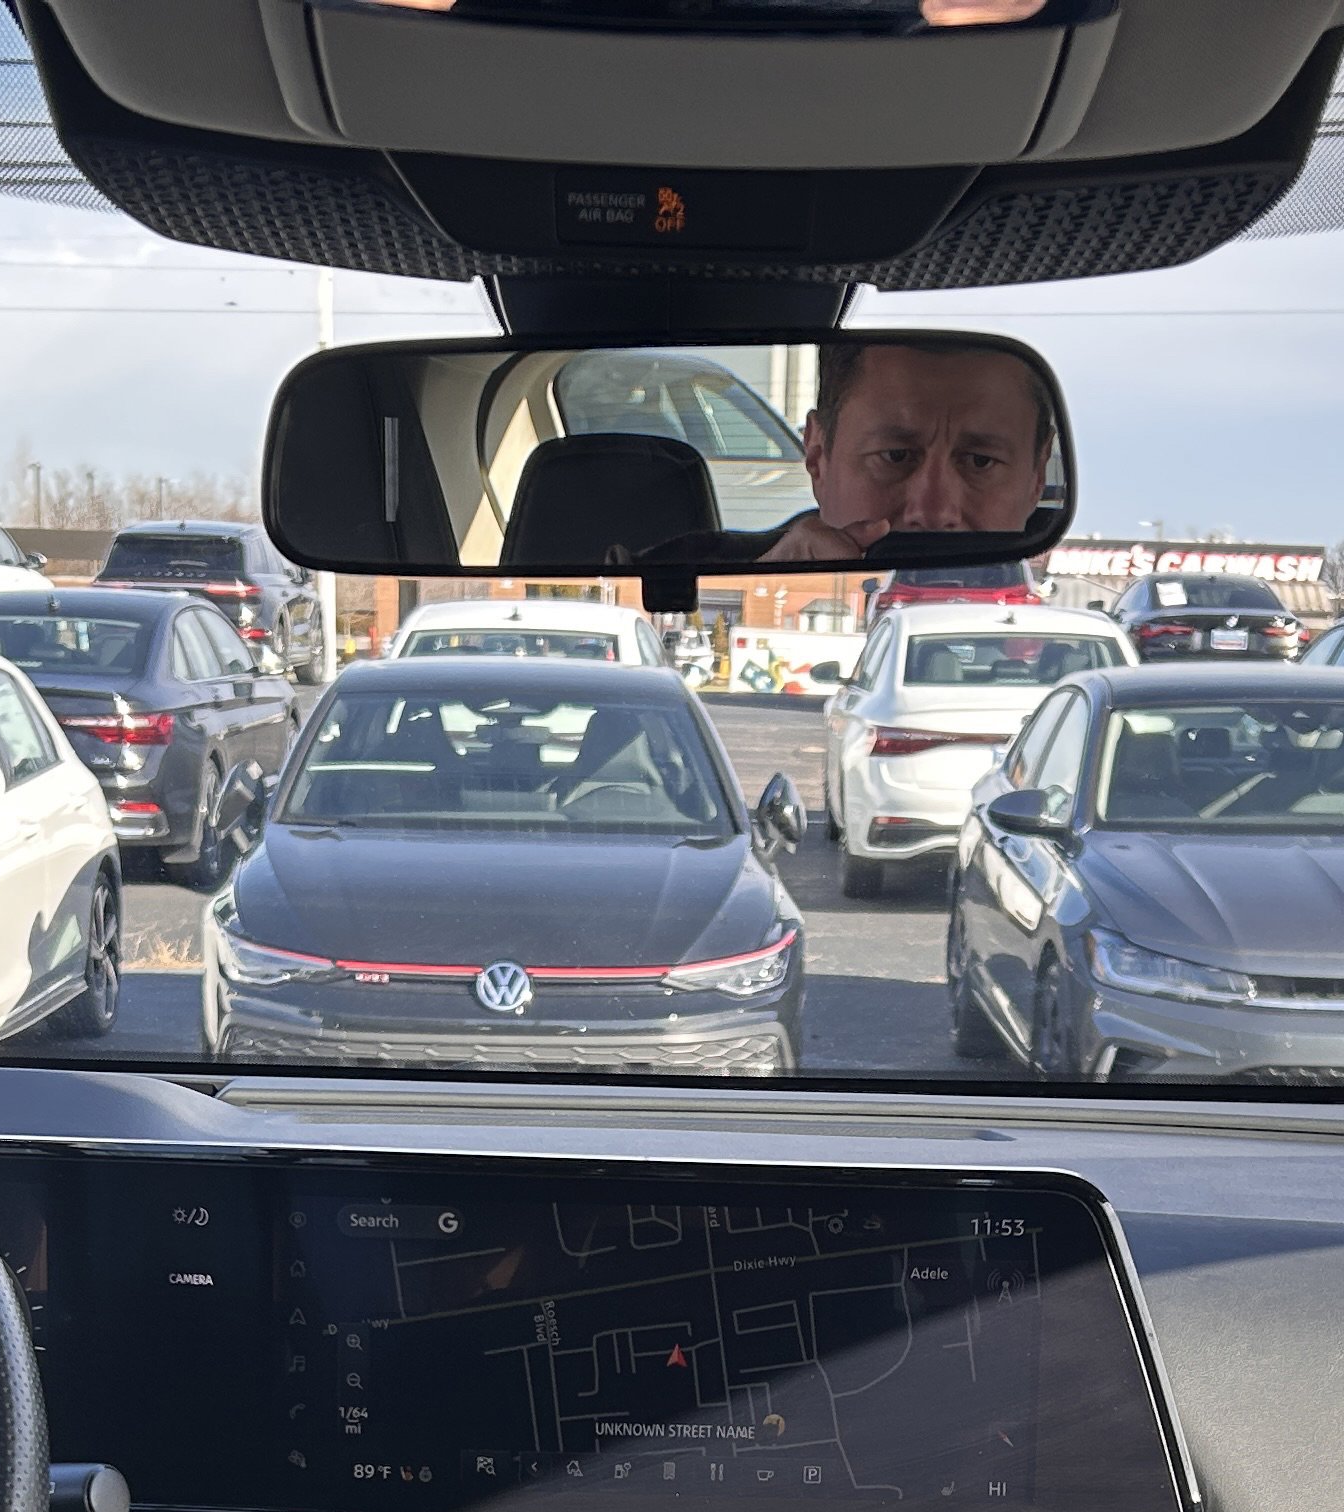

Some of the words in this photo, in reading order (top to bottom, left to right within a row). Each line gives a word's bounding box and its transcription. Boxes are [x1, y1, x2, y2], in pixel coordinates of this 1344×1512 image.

[567, 191, 646, 208] PASSENGER
[578, 208, 602, 222] AIR
[606, 208, 634, 222] BAG
[655, 217, 686, 232] OFF
[1046, 544, 1155, 577] MIKE'S
[1156, 551, 1324, 582] CARWASH
[349, 1213, 399, 1229] Search
[971, 1218, 1025, 1237] 11:53
[733, 1258, 765, 1272] Dixie
[768, 1256, 797, 1269] Hwy
[168, 1273, 214, 1287] CAMERA
[910, 1266, 949, 1280] Adele
[533, 1313, 547, 1343] Blvd
[544, 1300, 562, 1346] Roesch
[338, 1406, 369, 1419] 1/64
[345, 1423, 362, 1435] mi
[594, 1422, 665, 1437] UNKNOWN
[668, 1424, 713, 1438] STREET
[716, 1425, 756, 1440] NAME
[988, 1481, 1007, 1497] HI
